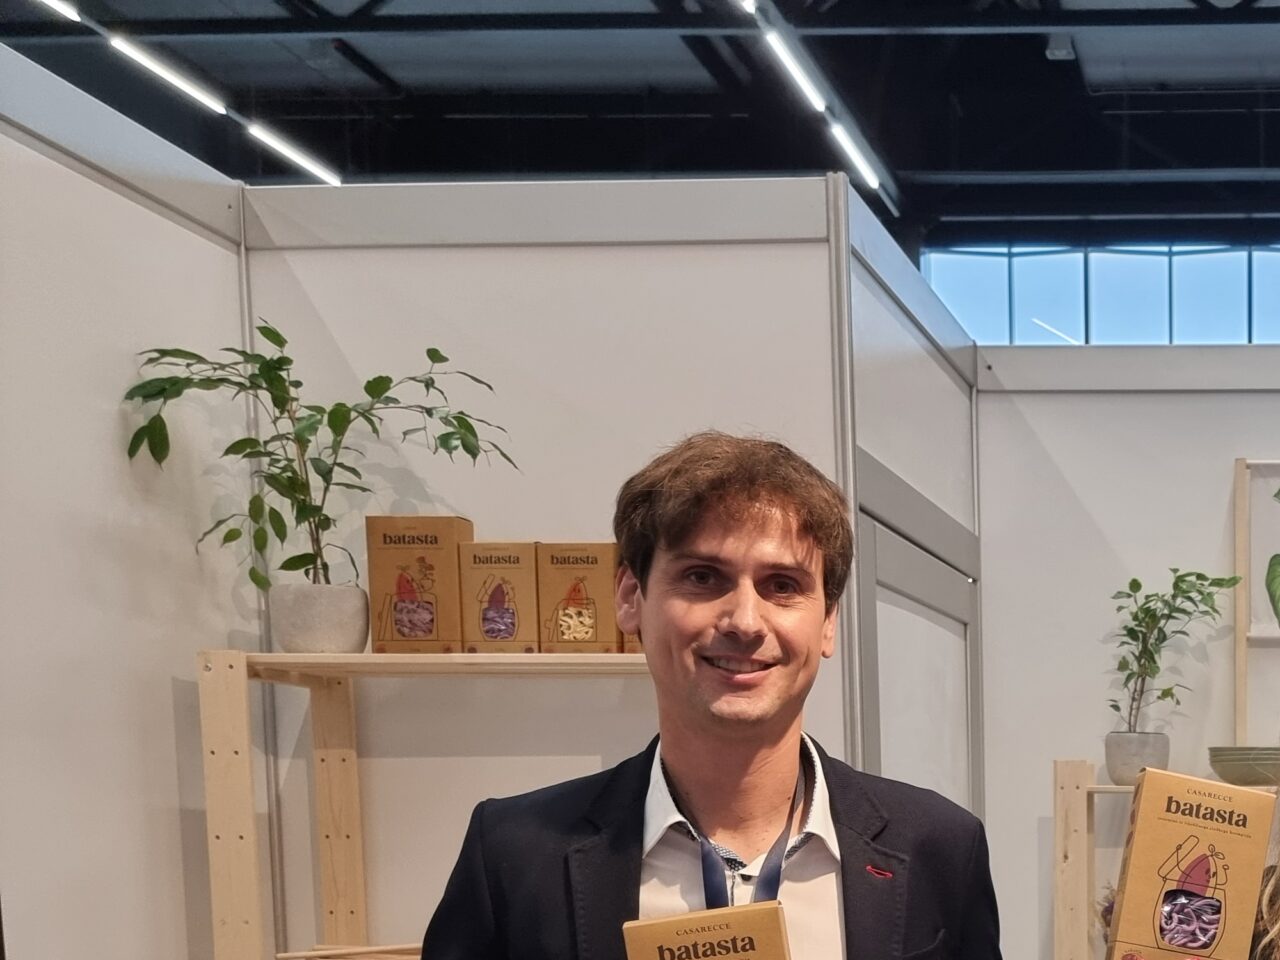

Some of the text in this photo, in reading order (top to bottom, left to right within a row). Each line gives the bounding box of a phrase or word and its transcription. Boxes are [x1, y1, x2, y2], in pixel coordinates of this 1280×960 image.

[382, 533, 439, 545] batasta
[472, 553, 520, 565] batasta
[550, 554, 599, 565] batasta
[1186, 788, 1234, 803] CASARECCE
[1164, 796, 1249, 828] batasta
[675, 923, 732, 937] CASARECCE
